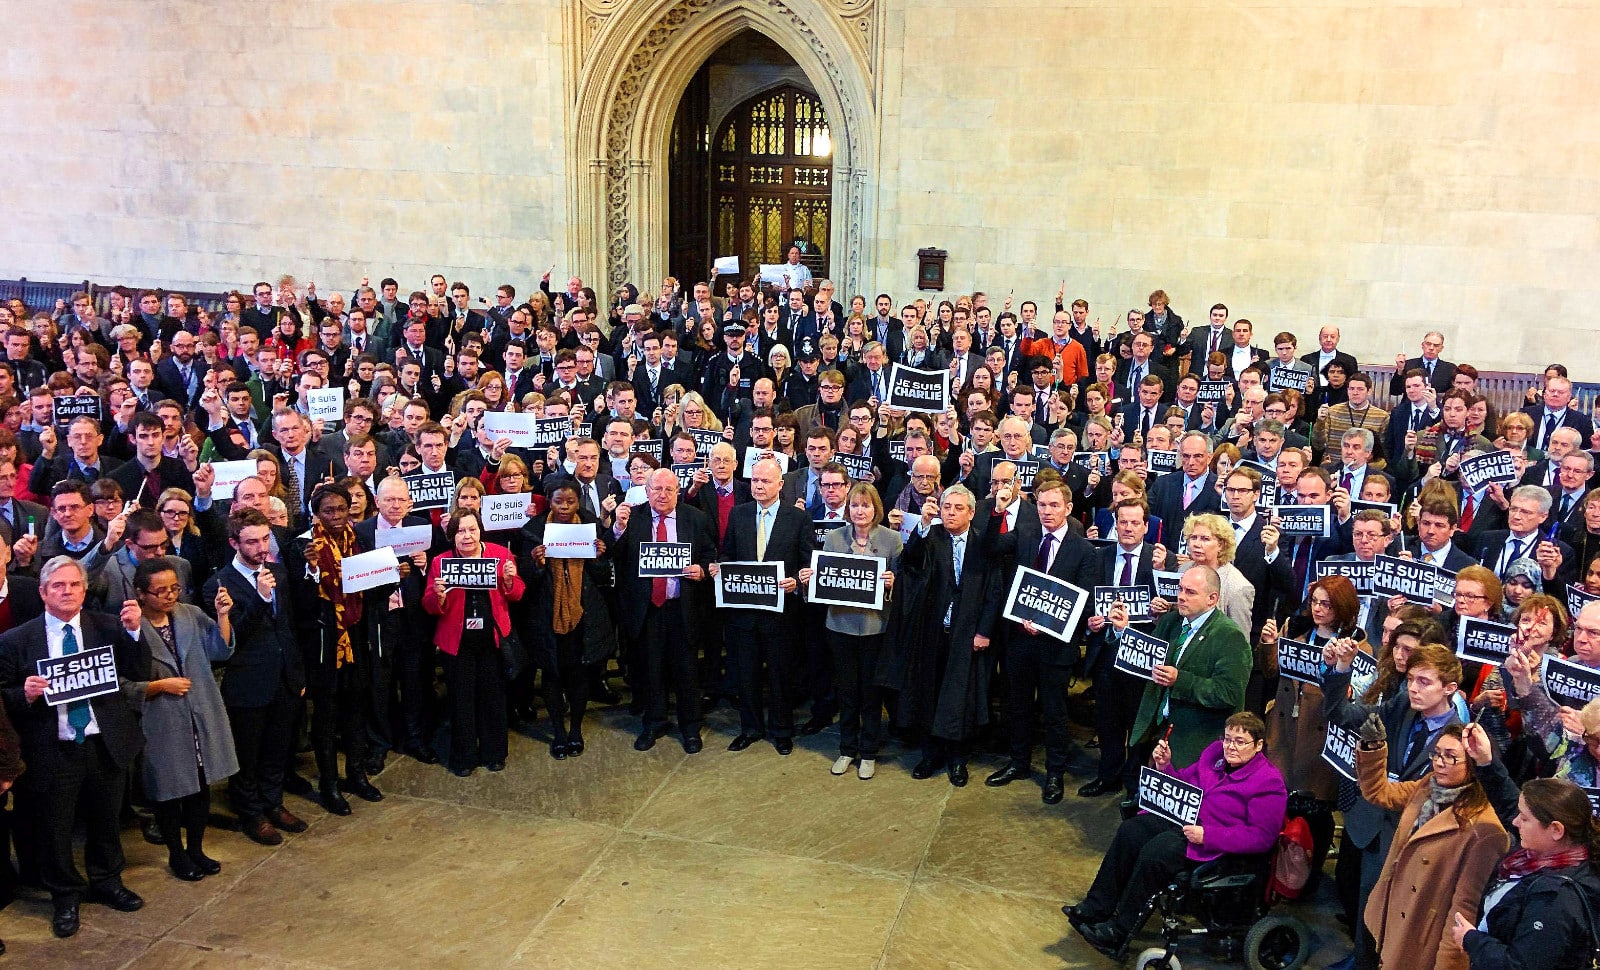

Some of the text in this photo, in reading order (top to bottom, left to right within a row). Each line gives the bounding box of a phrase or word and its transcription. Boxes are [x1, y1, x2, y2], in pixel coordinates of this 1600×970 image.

[1274, 370, 1286, 378] JE
[895, 379, 941, 391] JE SUIS
[1273, 377, 1306, 390] CHARLIE
[318, 394, 337, 403] suis
[894, 387, 941, 400] CHARLIE
[57, 405, 96, 415] CHARLIE
[544, 420, 569, 431] SUIS
[639, 443, 662, 453] SUIS
[844, 457, 870, 469] SUIS
[1464, 455, 1511, 474] JE SUIS
[1016, 466, 1037, 475] UIS
[1465, 464, 1515, 489] CHARLIE
[422, 476, 453, 488] SUIS
[490, 500, 523, 510] Je suis
[490, 512, 523, 522] Charlie
[1280, 522, 1323, 531] CHARLIE
[641, 547, 690, 557] JE SUIS
[442, 563, 496, 574] JE SUIS
[640, 556, 690, 569] CHARLIE
[819, 566, 875, 580] JE SUIS
[1319, 566, 1375, 577] JE SUIS
[1375, 559, 1434, 580] JE SUIS
[442, 574, 496, 586] CHARLIE
[725, 574, 776, 584] JE SUIS
[819, 575, 875, 592] CHARLIE
[724, 582, 777, 595] CHARLIE
[1374, 573, 1434, 599] CHARLIE
[1022, 584, 1072, 609] JE SUIS
[1096, 592, 1113, 602] JE
[1017, 593, 1069, 621] CHARLIE
[1467, 631, 1486, 640] JE
[1121, 633, 1165, 658] JE SUIS
[1280, 644, 1298, 658] JE
[42, 652, 112, 679] JE SUIS
[1548, 671, 1600, 694] JE SUIS
[1329, 724, 1346, 741] JE
[1140, 775, 1200, 806] JE SUIS
[1139, 786, 1198, 824] CHARLIE
